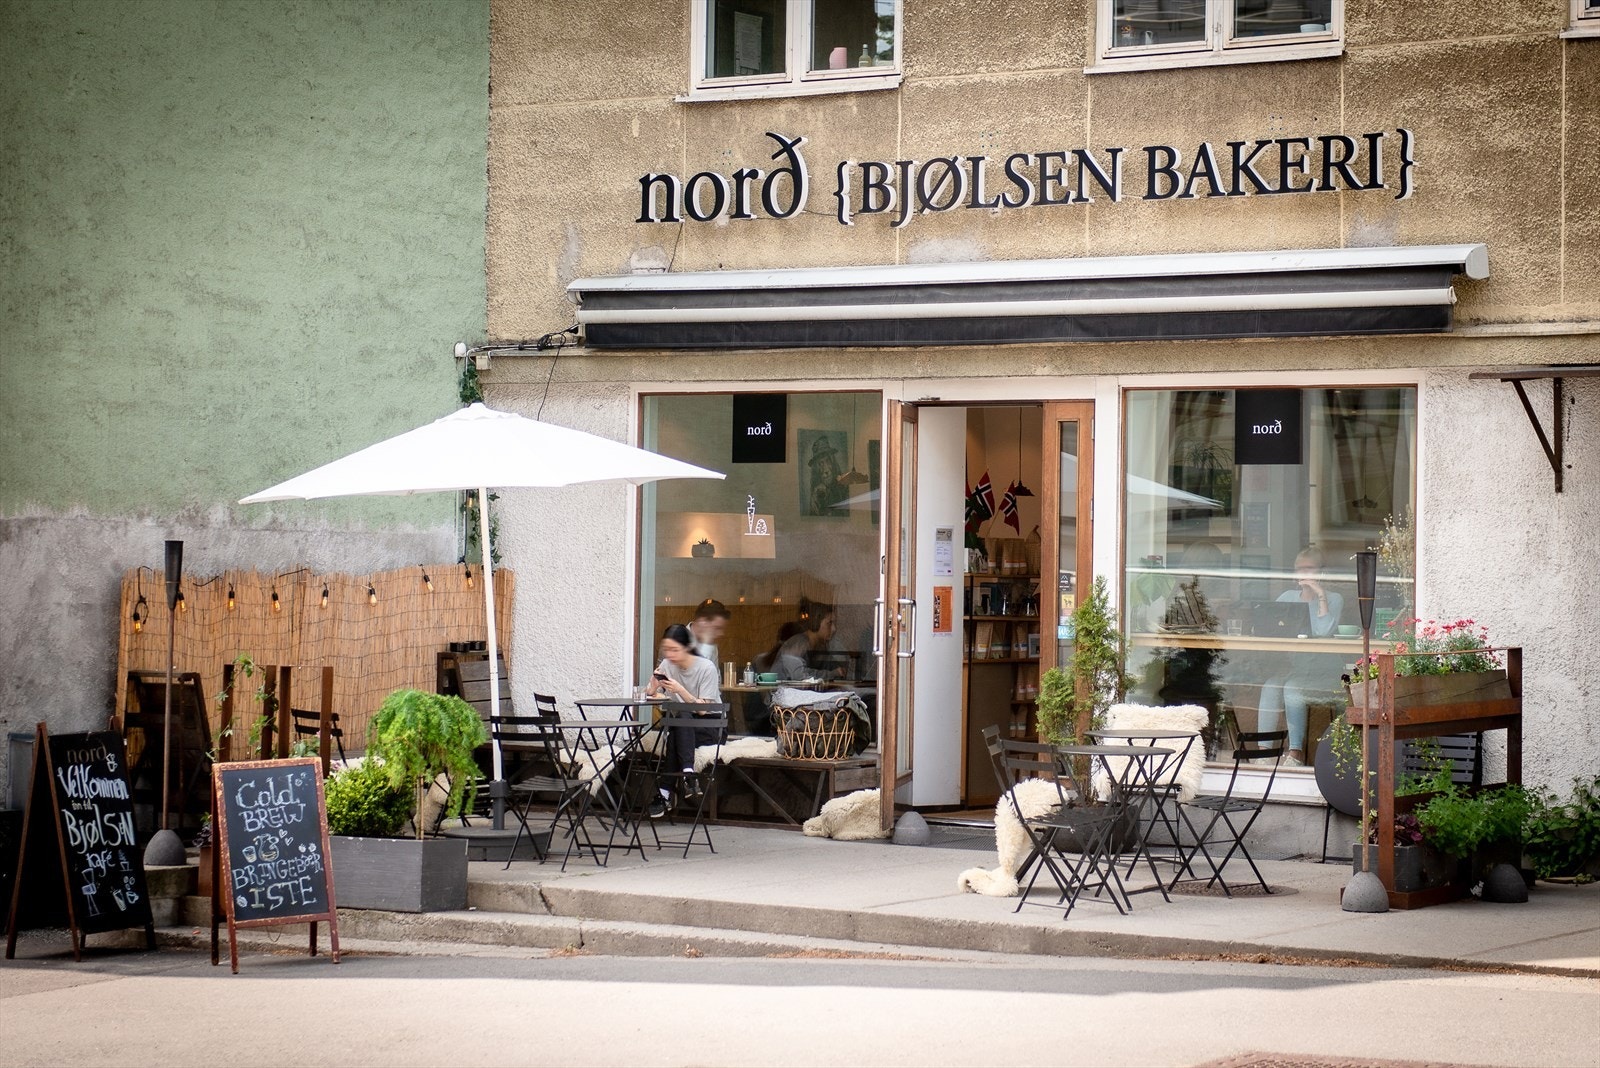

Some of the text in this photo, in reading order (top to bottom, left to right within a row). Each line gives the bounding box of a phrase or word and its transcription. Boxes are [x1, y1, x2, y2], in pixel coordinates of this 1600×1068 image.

[235, 773, 301, 809] Cold
[239, 803, 306, 833] BREW
[249, 875, 317, 911] ISTE
